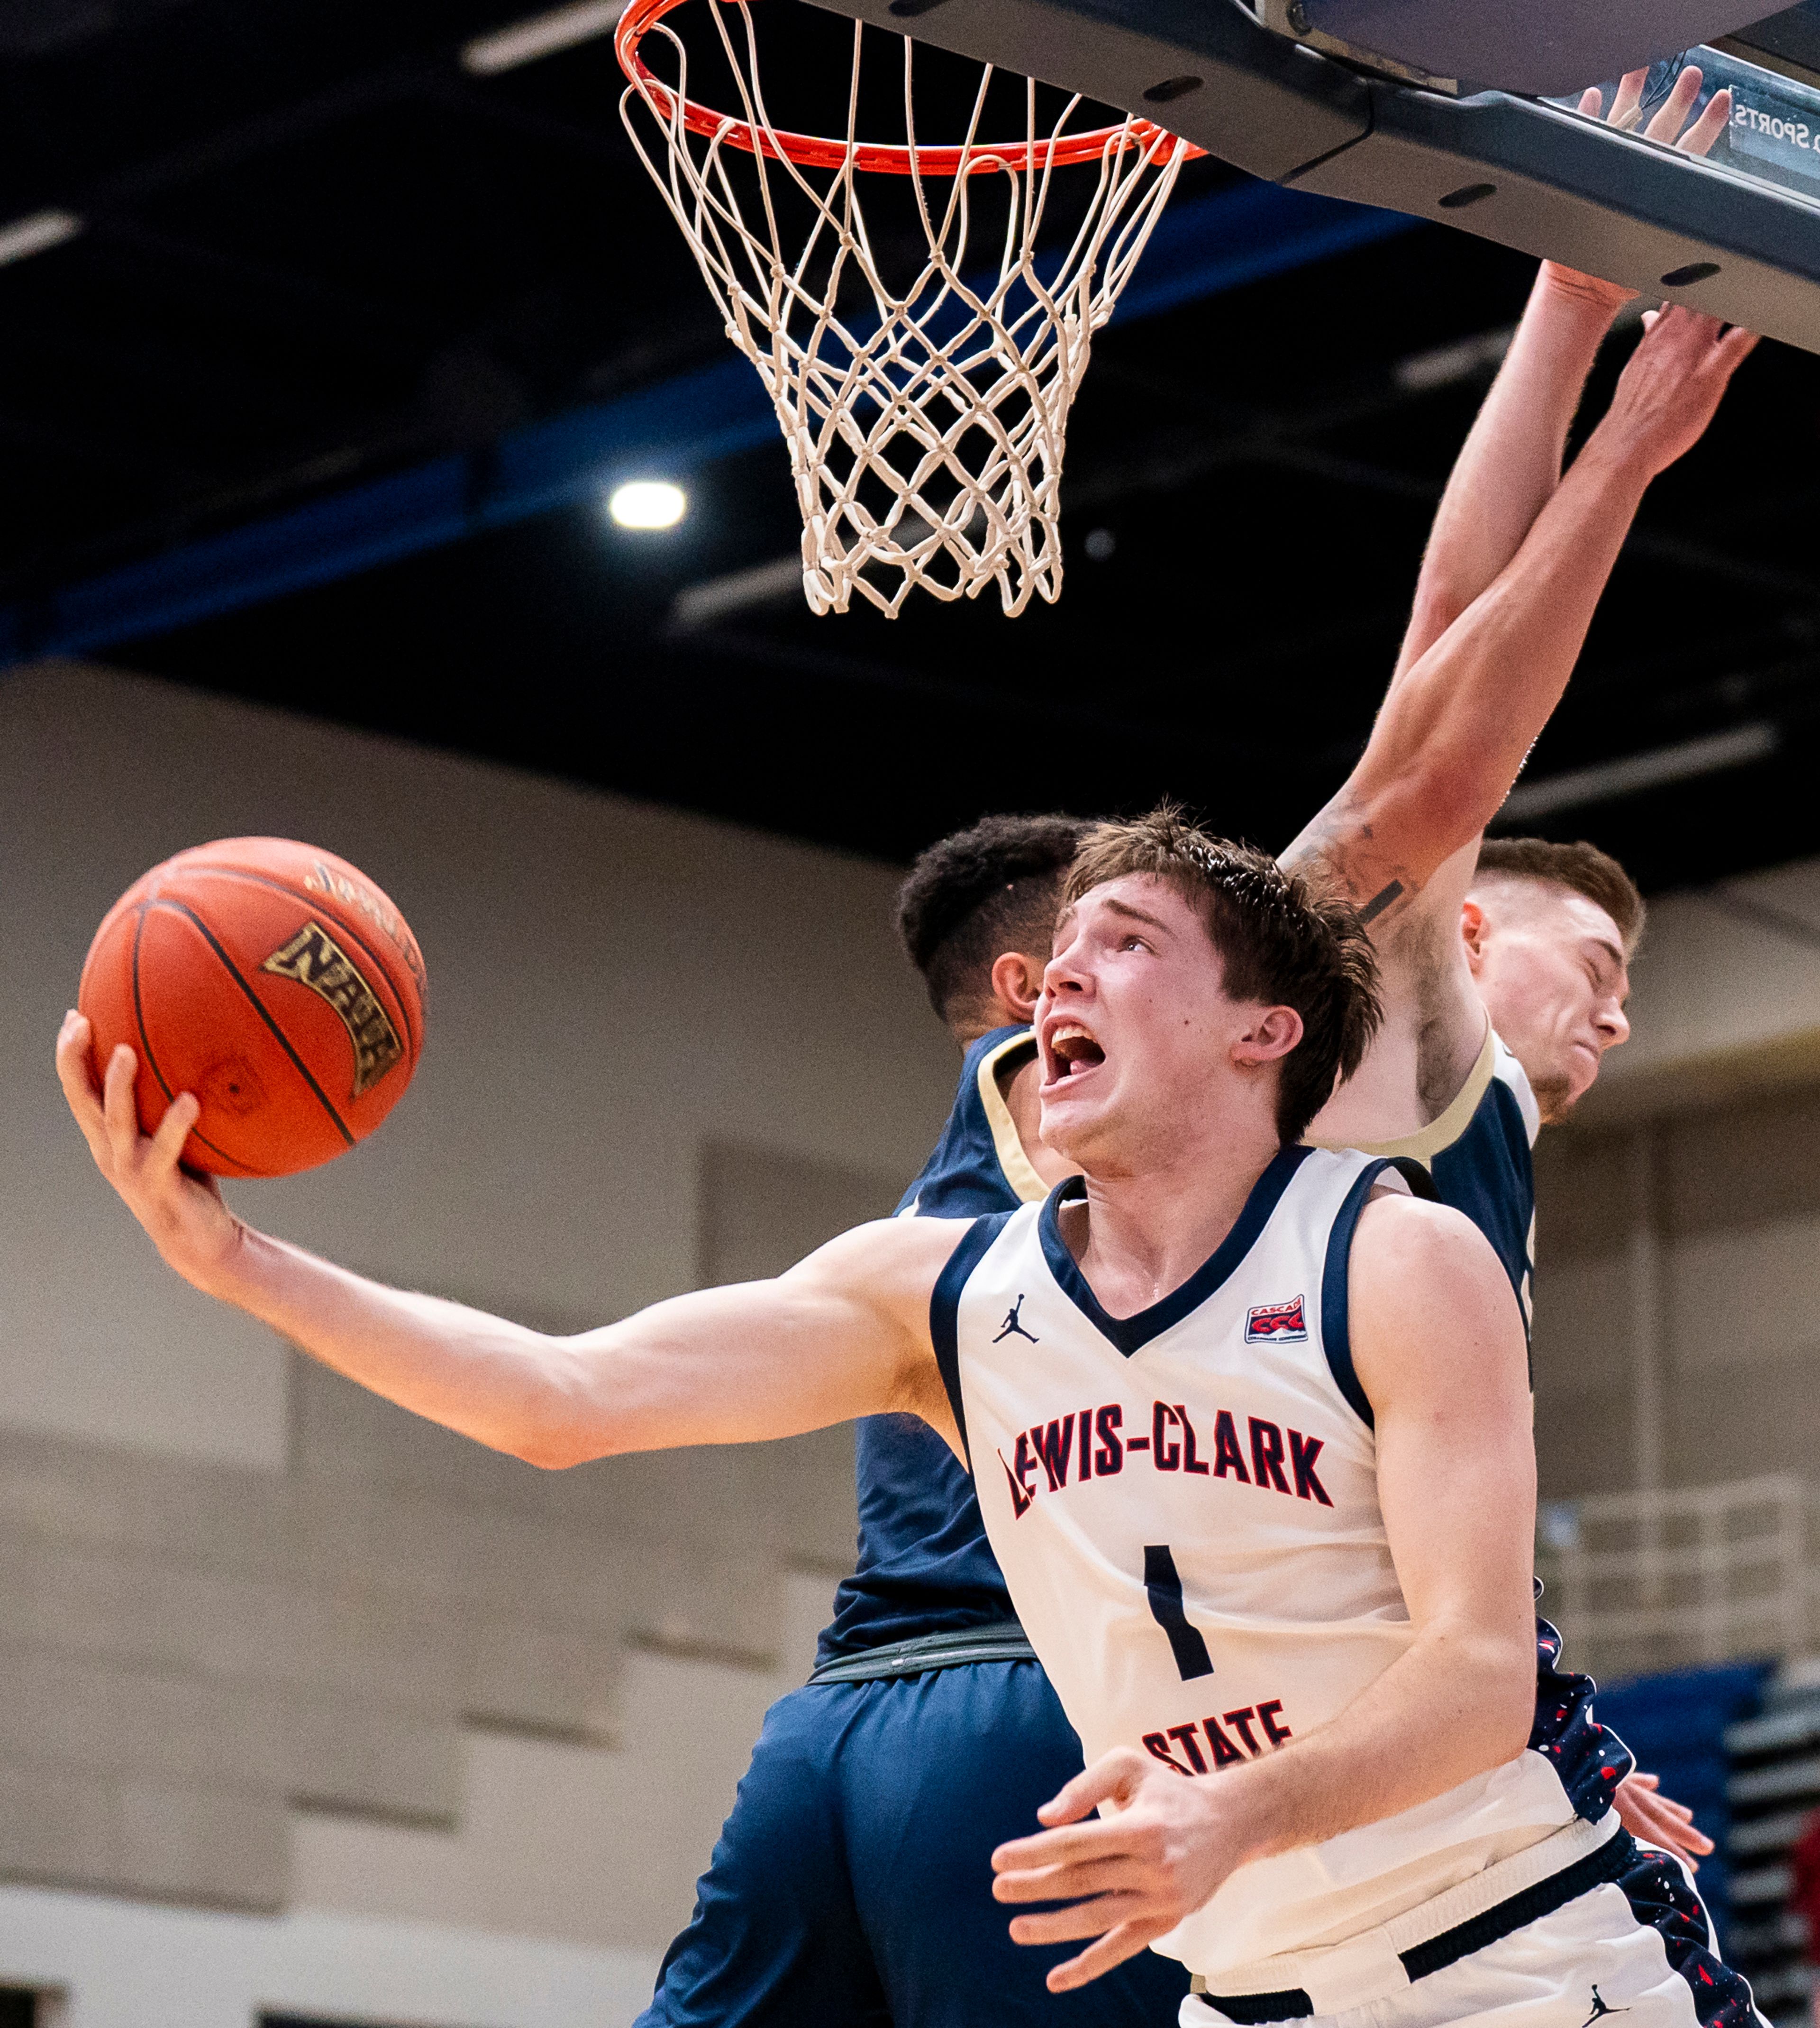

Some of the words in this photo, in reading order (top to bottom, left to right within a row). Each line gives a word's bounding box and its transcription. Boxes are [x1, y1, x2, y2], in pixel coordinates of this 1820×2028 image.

[1252, 1311, 1304, 1333] CCC
[998, 1400, 1334, 1520] LEWIS-CLARK
[1144, 1545, 1214, 1681] 1
[1142, 1699, 1292, 1776] STATE
